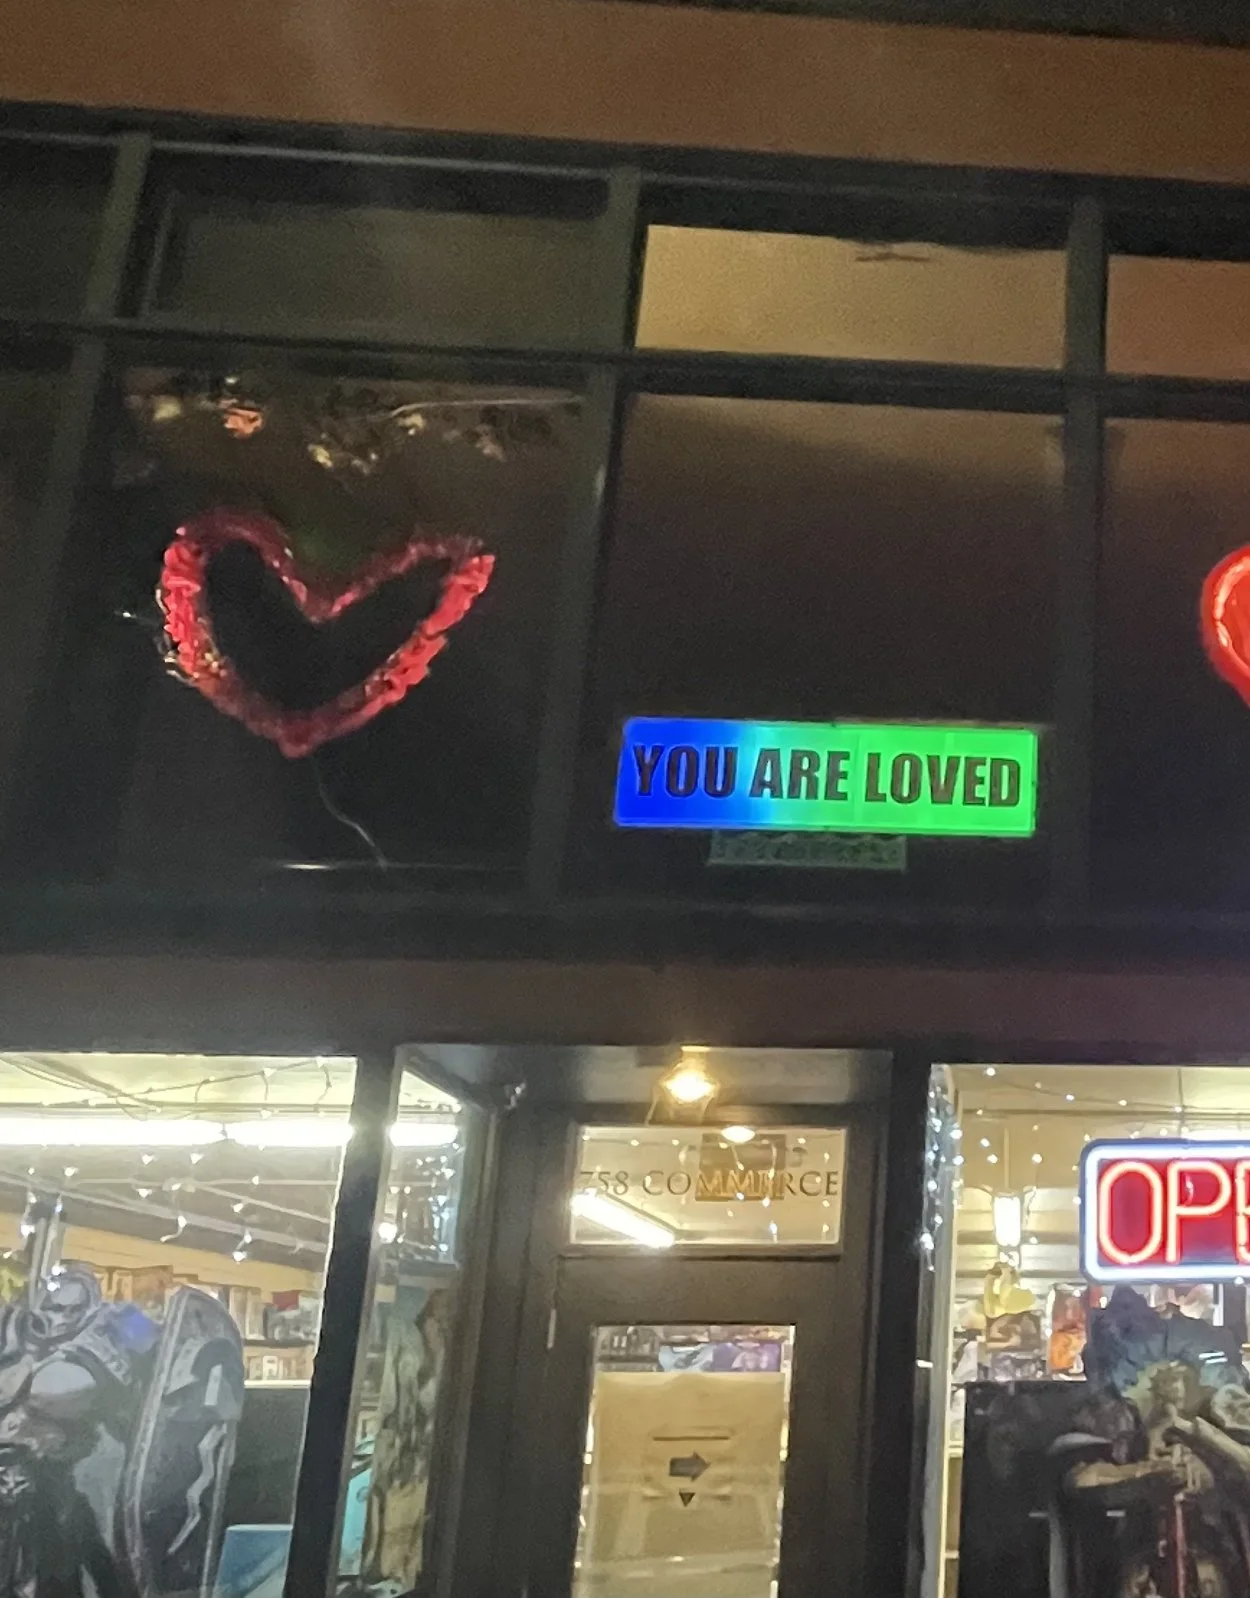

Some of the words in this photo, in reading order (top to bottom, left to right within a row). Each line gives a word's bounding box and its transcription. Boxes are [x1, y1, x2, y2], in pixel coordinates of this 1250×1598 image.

[633, 744, 738, 798] YOU
[748, 748, 851, 802] ARE
[865, 751, 1022, 807] LOVED
[580, 1170, 630, 1196] 758
[642, 1170, 839, 1197] COMMERCE
